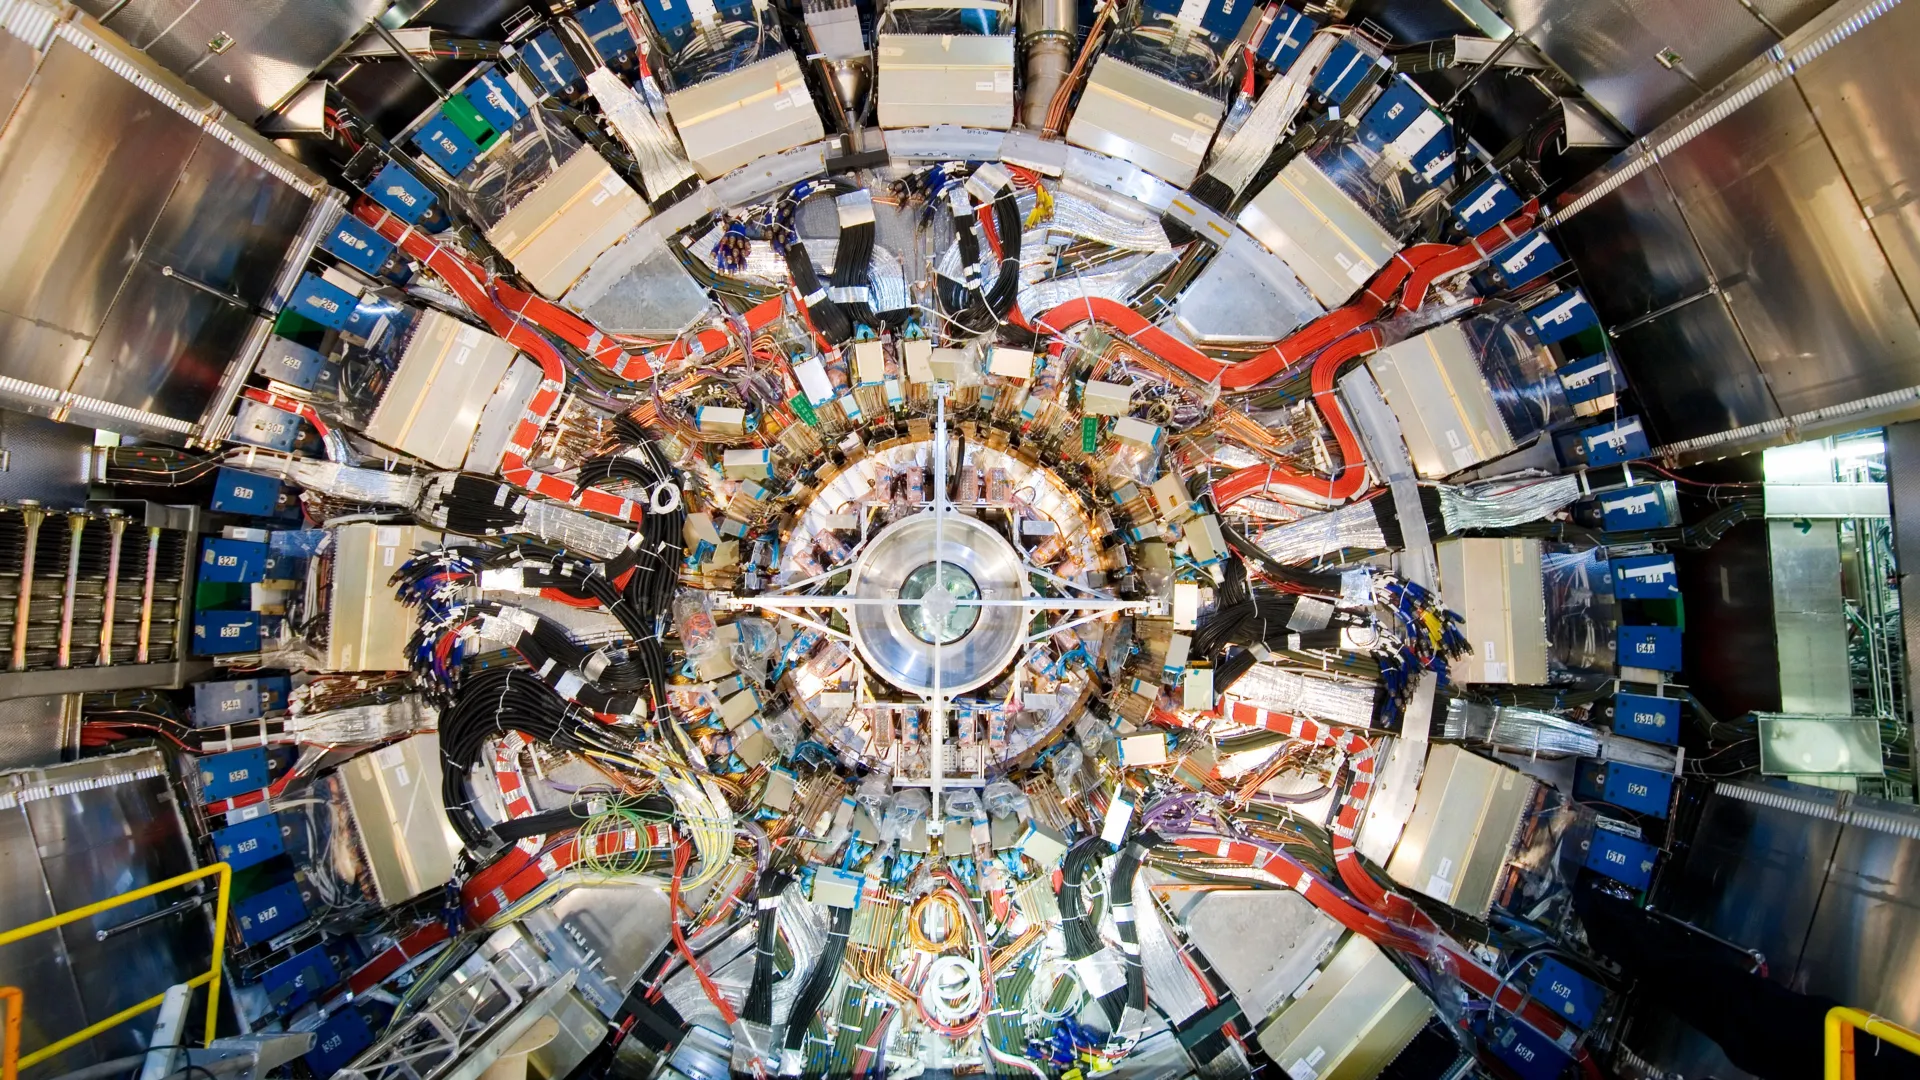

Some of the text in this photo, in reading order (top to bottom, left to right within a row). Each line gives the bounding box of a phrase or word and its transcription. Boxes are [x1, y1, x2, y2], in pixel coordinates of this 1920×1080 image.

[1390, 105, 1403, 117] 9A
[441, 139, 457, 154] 25A
[400, 191, 415, 206] 26A
[1481, 200, 1493, 212] 7A
[340, 232, 356, 246] 27A
[321, 299, 337, 312] 28A
[1557, 312, 1570, 323] 5A
[284, 356, 300, 369] 29A
[267, 423, 283, 434] 30A
[1612, 436, 1624, 446] 3A
[236, 488, 252, 499] 31A
[1630, 504, 1643, 514] 2A
[219, 556, 236, 567] 32A
[1649, 573, 1662, 583] 1A
[221, 628, 239, 637] 33A
[1637, 643, 1655, 653] 64A
[222, 700, 240, 710] 34A
[1635, 713, 1653, 724] 63A
[230, 770, 248, 781] 35A
[1628, 783, 1647, 796] 62A
[239, 839, 256, 853] 36A
[1607, 850, 1625, 864] 61A
[259, 907, 277, 923] 37A
